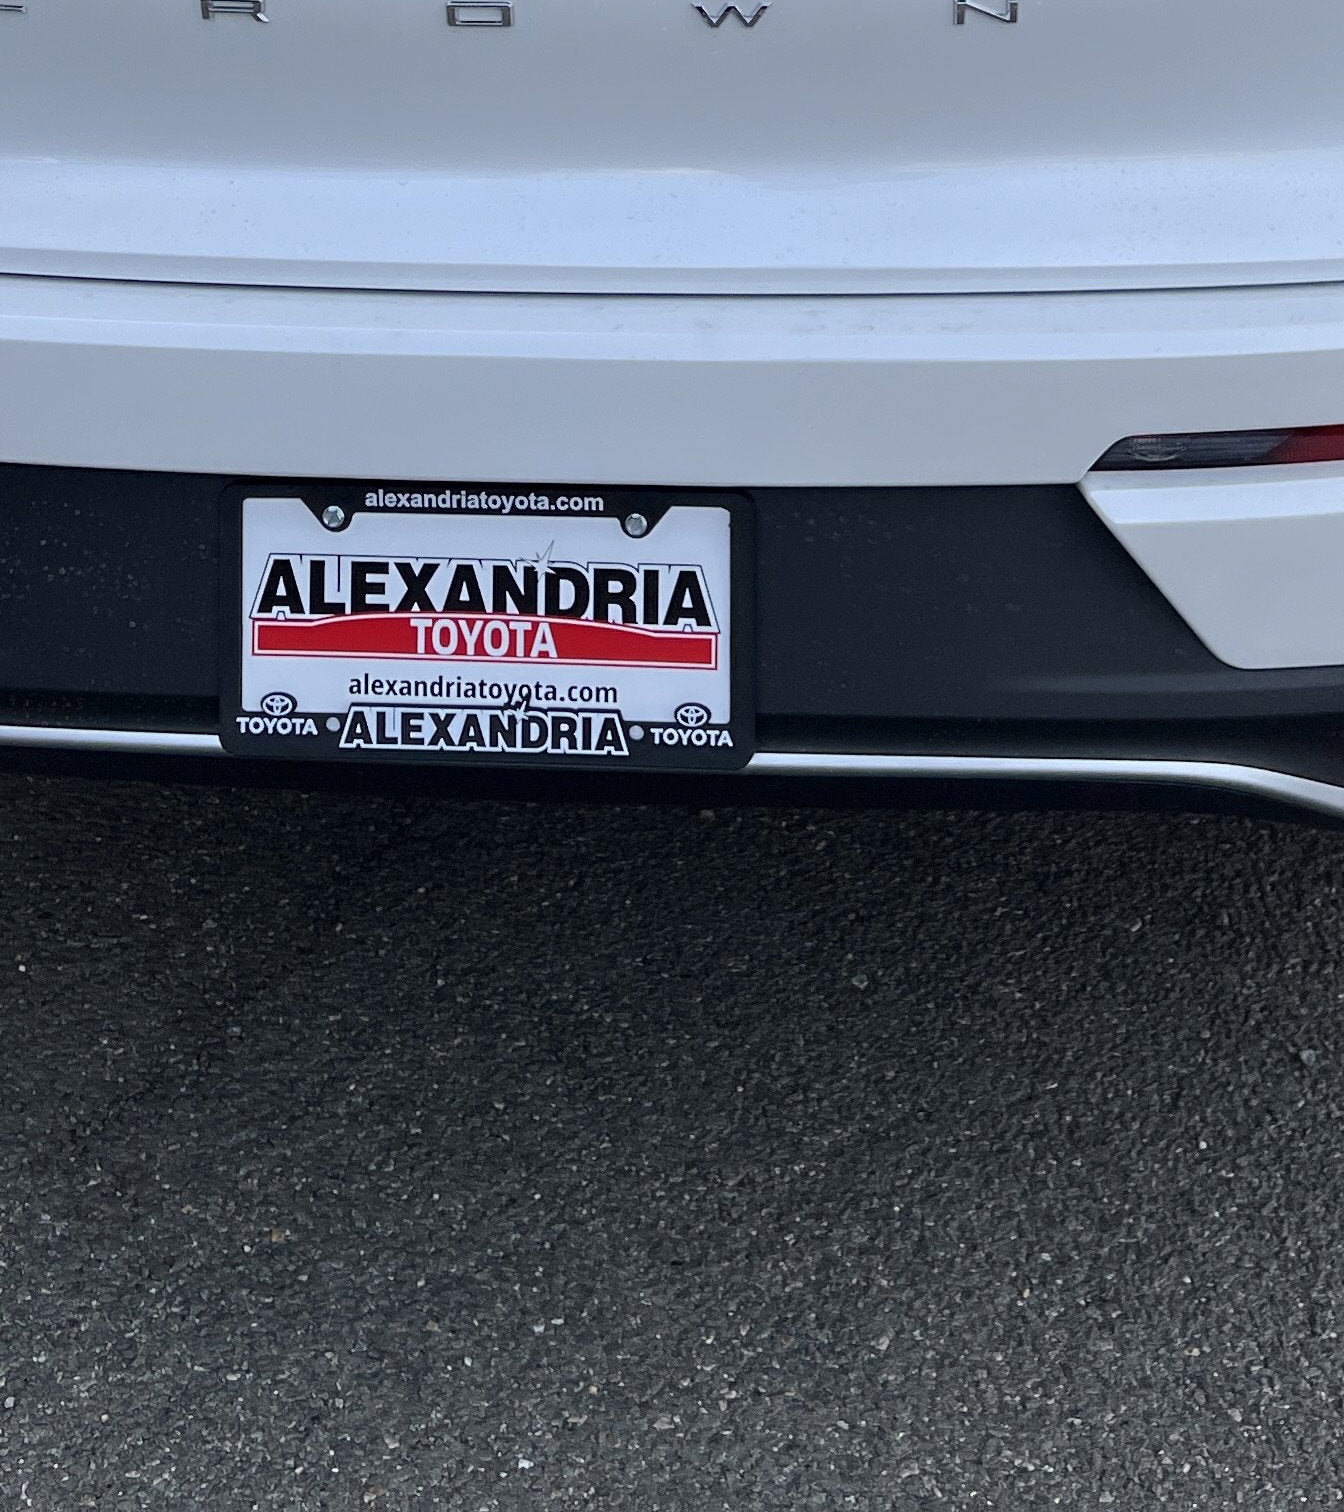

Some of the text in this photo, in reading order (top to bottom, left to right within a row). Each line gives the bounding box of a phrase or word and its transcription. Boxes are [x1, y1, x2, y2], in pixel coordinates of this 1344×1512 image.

[364, 488, 605, 512] alexandriatoyota.com
[255, 557, 714, 628] ALEXANDRIA
[409, 617, 559, 658] TOYOTA
[348, 673, 618, 705] alexandriatoyota.com
[236, 715, 318, 737] TOYOTA
[340, 706, 629, 755] ALEXANDRIA
[650, 725, 734, 748] TOYOTA
